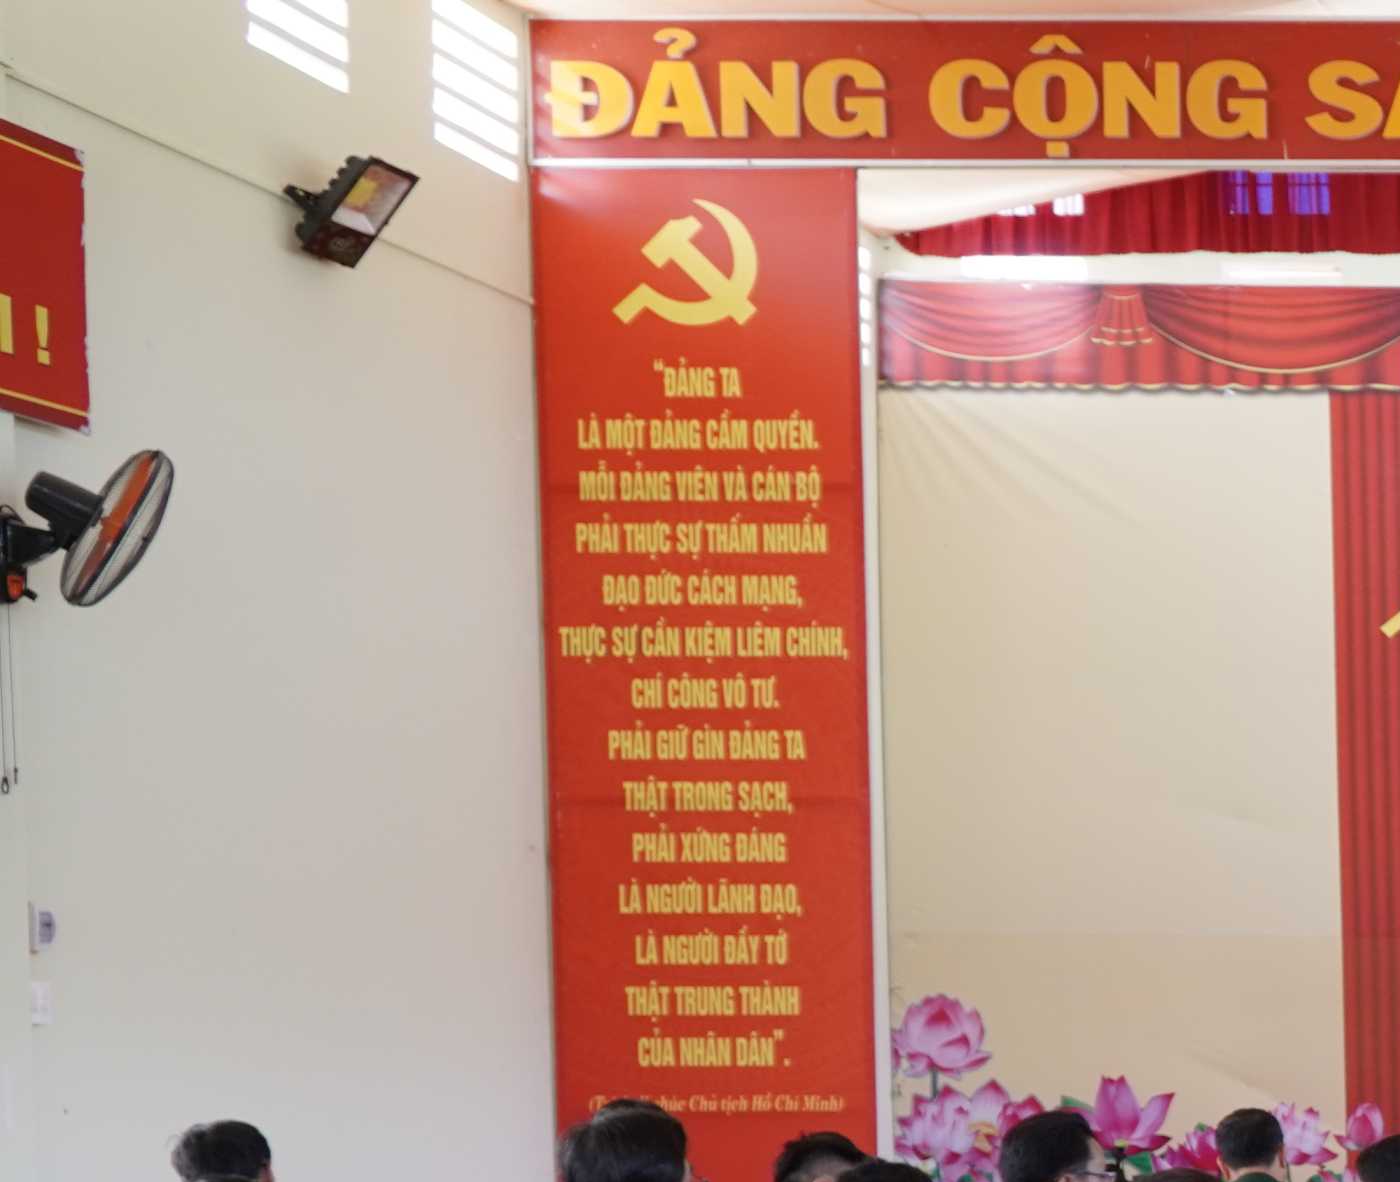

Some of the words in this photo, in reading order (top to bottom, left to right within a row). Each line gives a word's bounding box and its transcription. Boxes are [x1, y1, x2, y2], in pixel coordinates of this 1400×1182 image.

[543, 27, 888, 139] ĐẢNG
[928, 33, 1269, 158] CỘNG
[652, 355, 717, 398] “ĐẢNG
[719, 366, 743, 399] TA
[602, 574, 640, 612] ĐẠO
[645, 569, 683, 606] ĐỨC
[686, 568, 738, 606] CÁCH
[741, 574, 804, 612] MẠNG,
[630, 671, 664, 710] CHÍ
[667, 671, 719, 709] CÔNG
[722, 671, 747, 709] VÔ
[750, 675, 781, 709] TƯ.
[622, 775, 669, 818] THẬT
[671, 780, 734, 812] TRONG
[737, 780, 795, 818] SẠCH,
[637, 1026, 676, 1068] CỦA
[679, 1030, 732, 1067] NHÂN
[735, 1028, 793, 1068] DÂN”.
